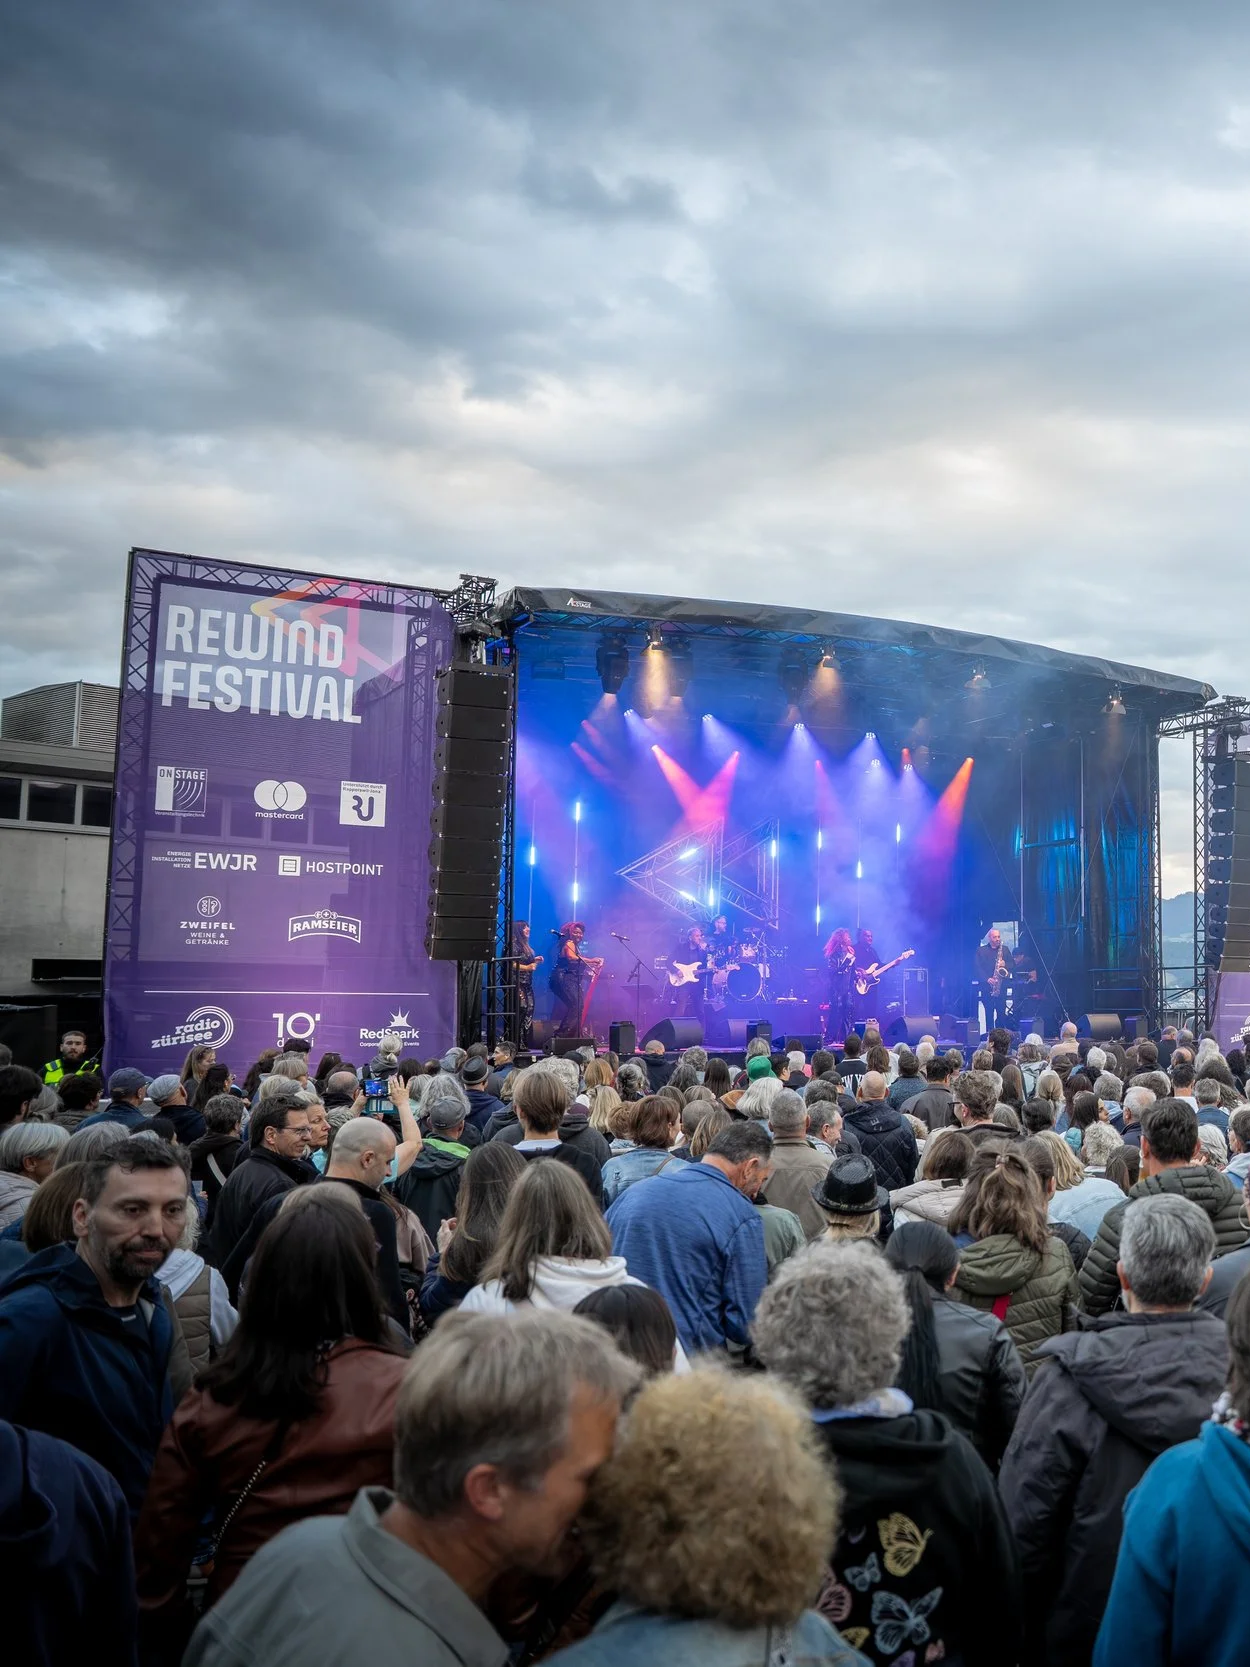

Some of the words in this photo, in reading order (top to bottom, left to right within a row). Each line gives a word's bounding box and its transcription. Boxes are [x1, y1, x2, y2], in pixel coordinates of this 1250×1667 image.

[165, 604, 343, 669] REWIND
[161, 659, 362, 724] FESTIVAL
[160, 769, 173, 778] ON
[175, 769, 206, 780] STAGE
[255, 811, 304, 820] mastercard
[194, 852, 257, 871] EWJR
[306, 861, 384, 876] HOSTPOINT
[180, 921, 236, 930] ZWEIFEL
[292, 919, 358, 935] RAMSEIER
[185, 938, 230, 946] GETRÄNKE
[175, 1018, 221, 1035] radio
[151, 1030, 213, 1049] zürisee
